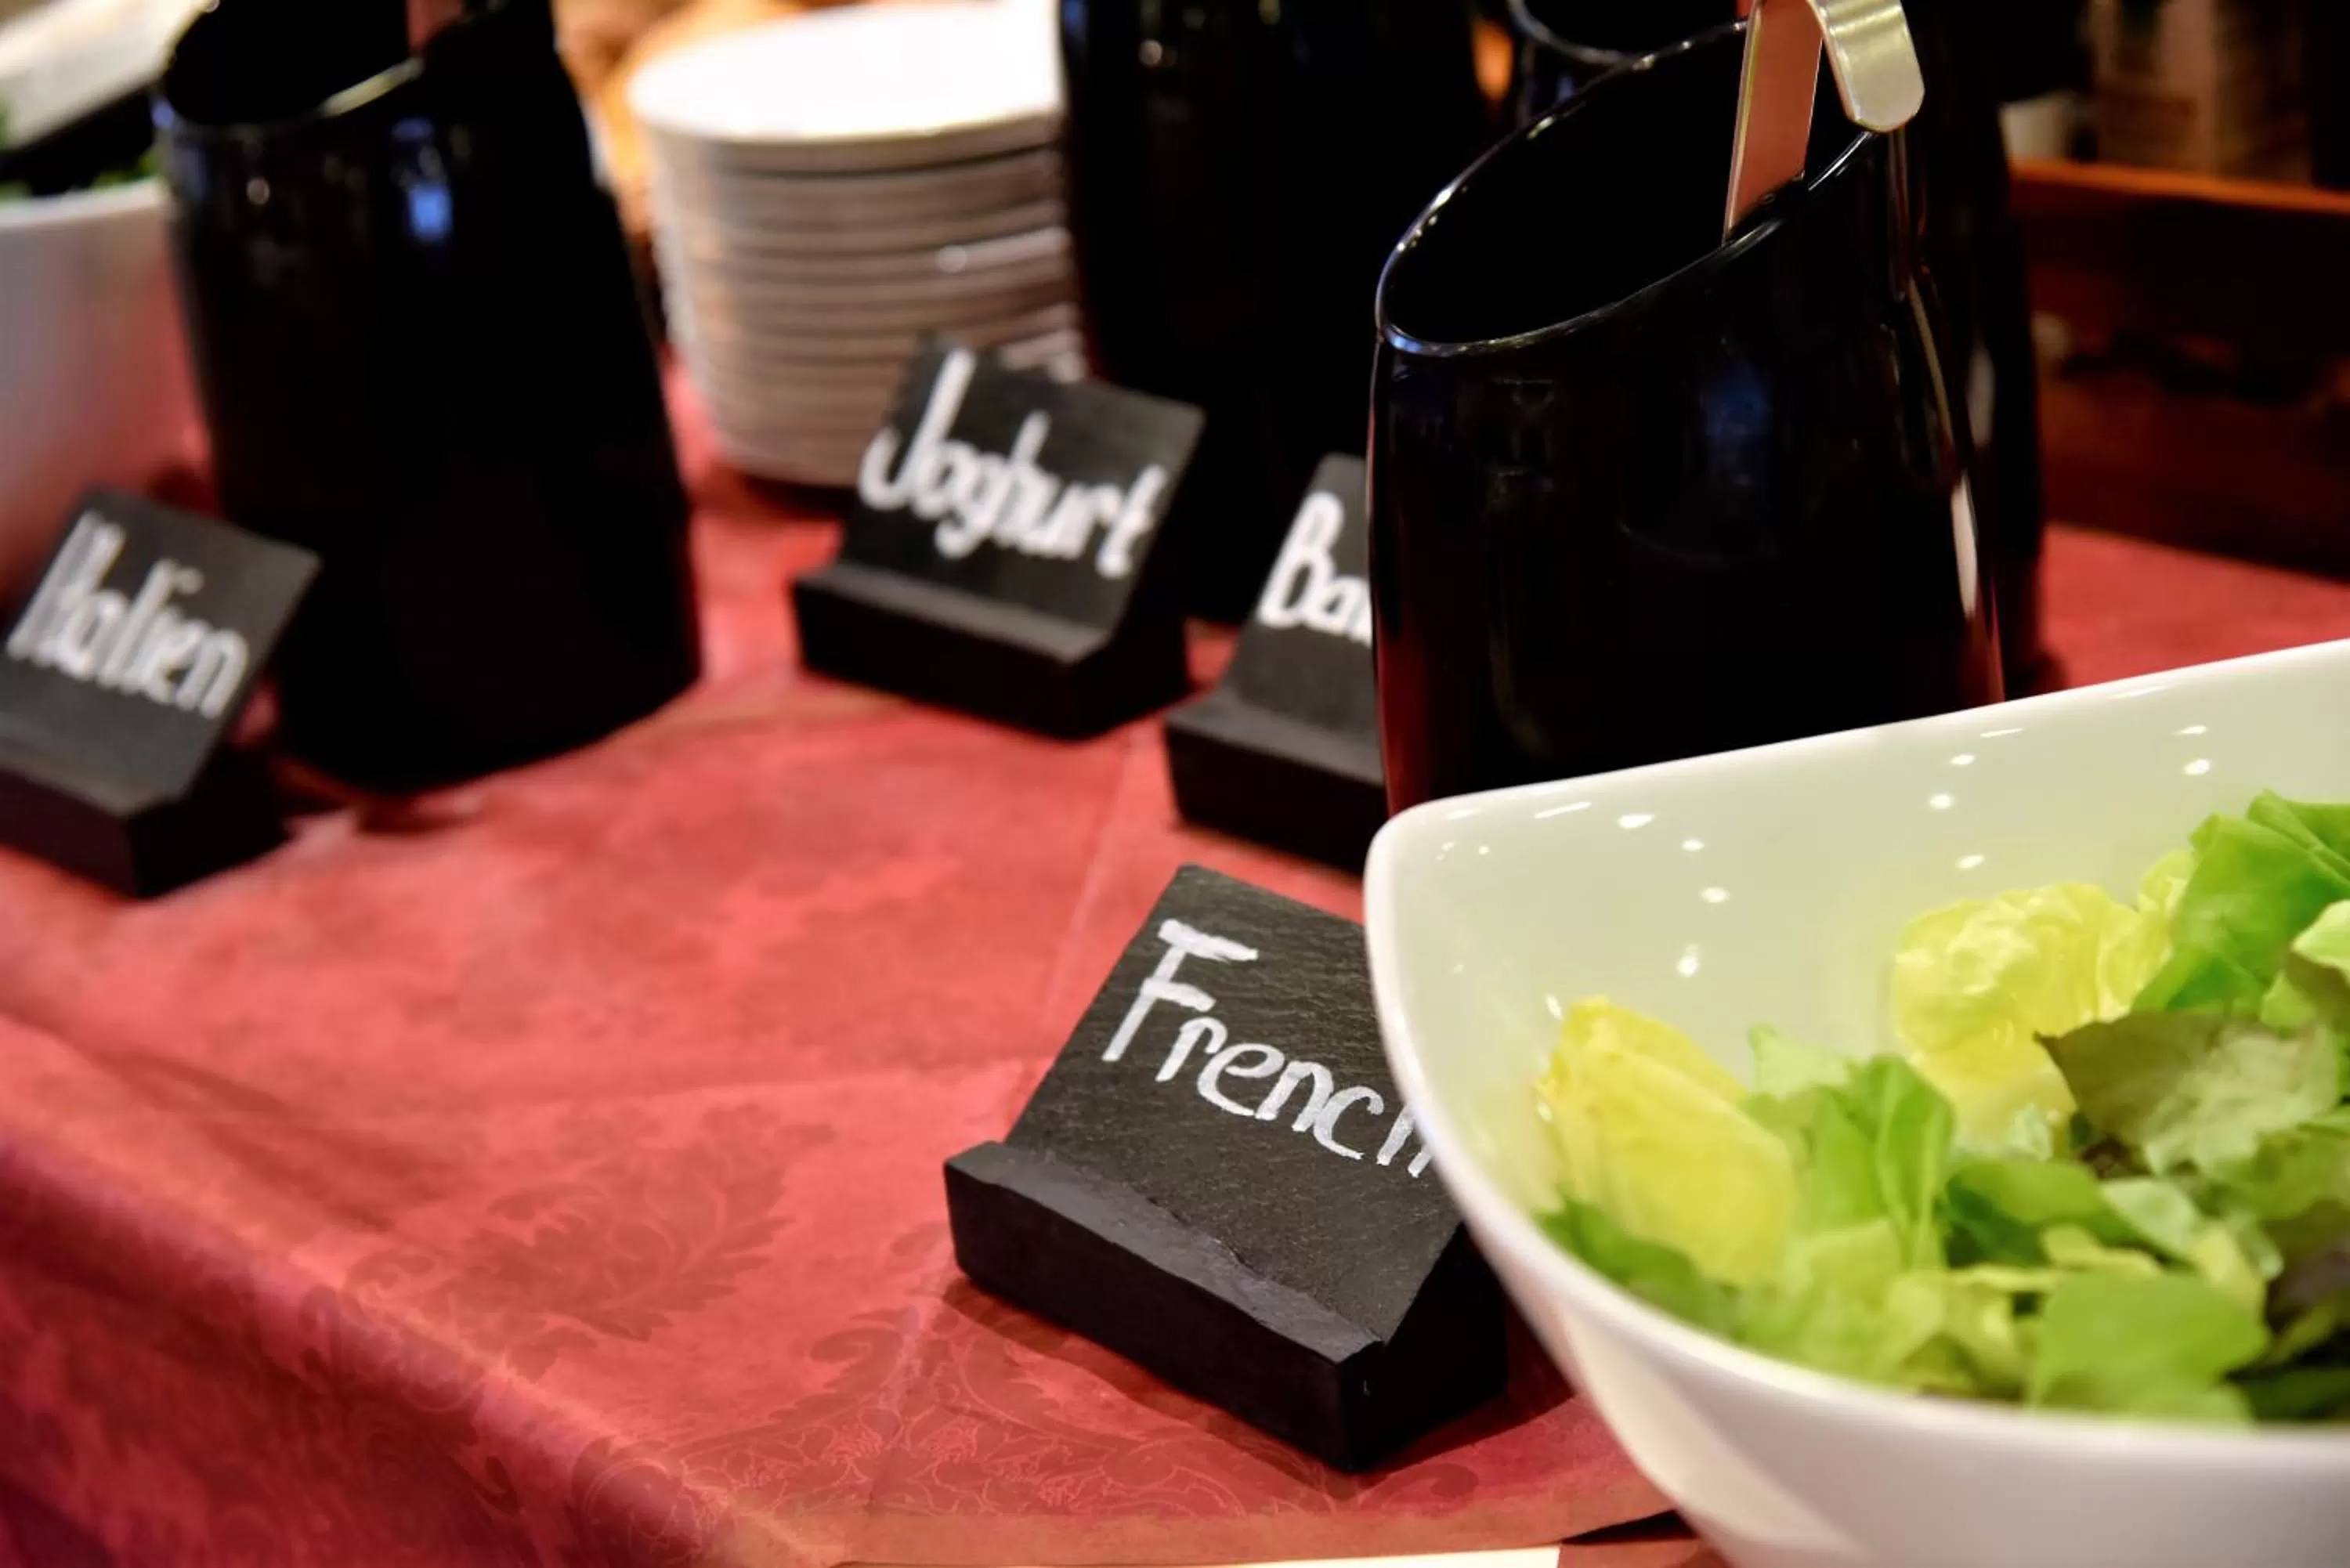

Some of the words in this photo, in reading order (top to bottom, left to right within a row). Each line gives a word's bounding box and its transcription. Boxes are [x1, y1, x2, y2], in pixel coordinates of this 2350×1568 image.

[859, 346, 1167, 576] Joghurt
[6, 511, 249, 717] Italien
[1259, 493, 1372, 647] Ba
